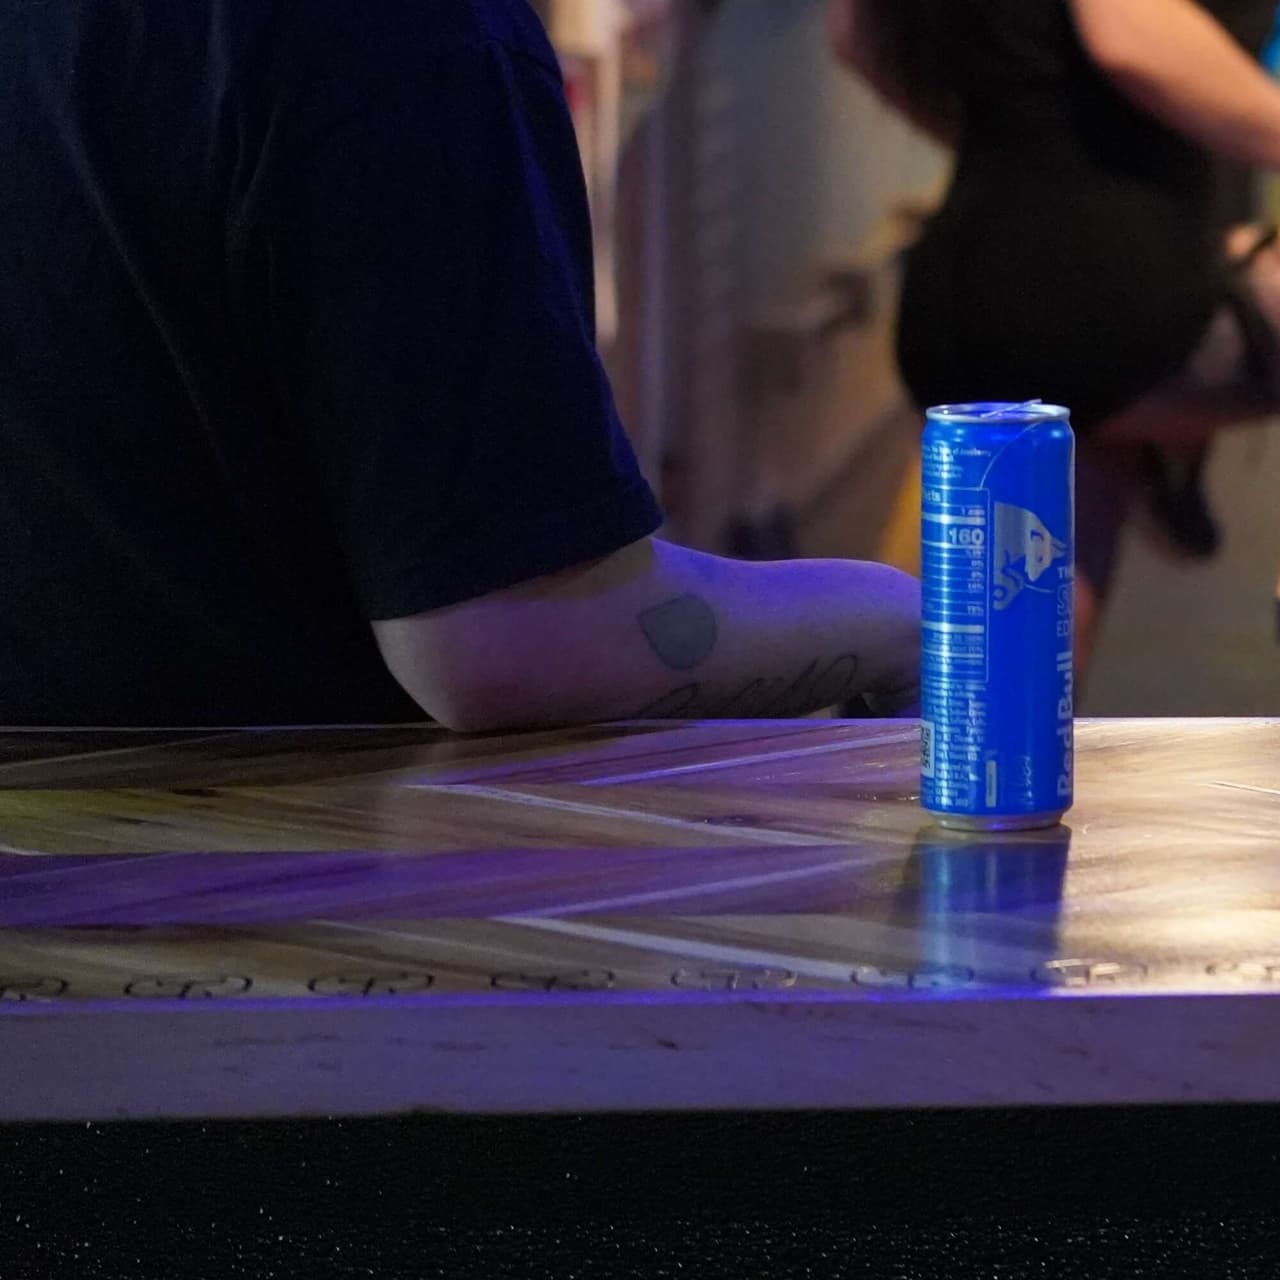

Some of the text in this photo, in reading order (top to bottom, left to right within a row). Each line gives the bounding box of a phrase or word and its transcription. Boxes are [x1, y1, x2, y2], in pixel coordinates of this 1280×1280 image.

[948, 527, 985, 545] 160
[1056, 651, 1073, 797] Red Bull
